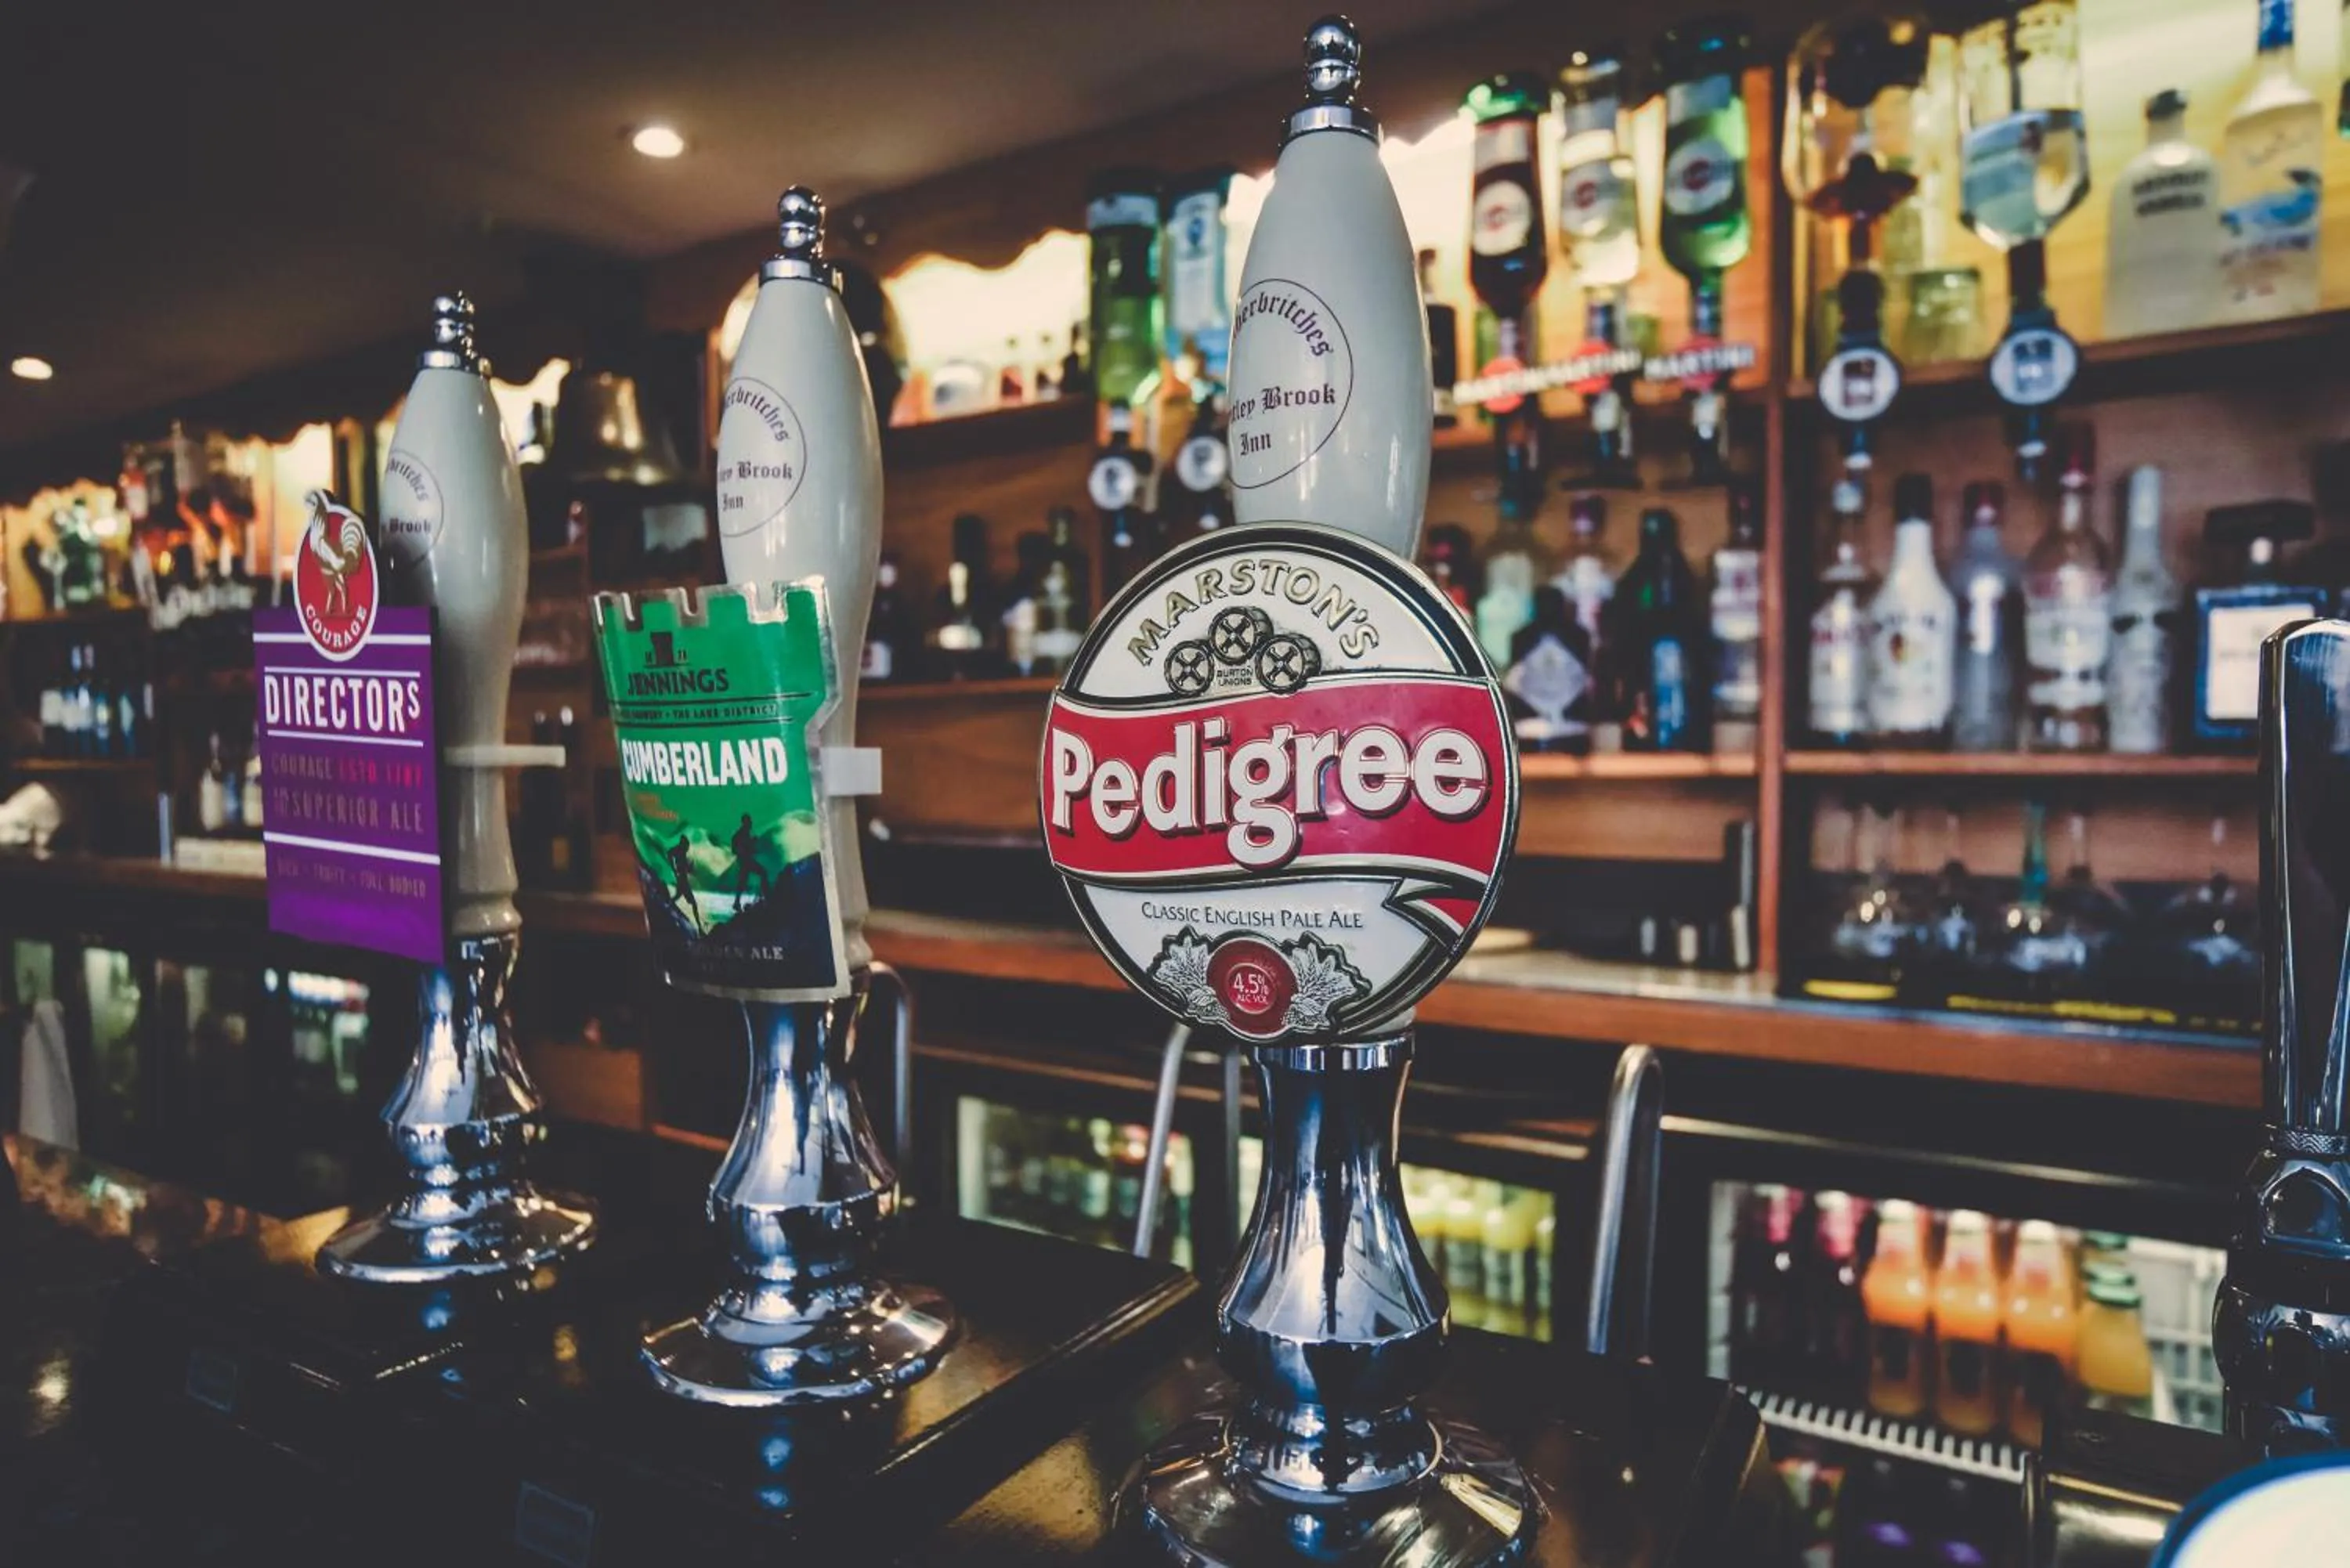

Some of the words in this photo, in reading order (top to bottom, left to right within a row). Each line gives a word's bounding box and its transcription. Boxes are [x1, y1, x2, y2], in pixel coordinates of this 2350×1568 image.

[1262, 383, 1336, 414] Brook
[1240, 432, 1271, 456] Inn
[737, 461, 793, 480] Brook
[306, 603, 367, 649] COURAGE
[1128, 558, 1380, 667] MARSTON'S
[628, 668, 730, 695] JENNINGS
[1217, 668, 1253, 677] BURTON
[264, 674, 421, 734] DIRECTORS
[272, 752, 333, 780] COURAGE
[621, 736, 788, 786] CUMBERLAND
[1052, 716, 1488, 871] Pedigree
[292, 789, 379, 829] SUPERIOR
[391, 799, 424, 834] ALE
[1141, 901, 1200, 923] CLASSIC
[1205, 906, 1275, 927] ENGLISH
[1281, 909, 1323, 928] PALE
[1329, 910, 1364, 929] ALE
[750, 946, 784, 960] ALE
[1233, 973, 1269, 995] 4.5%
